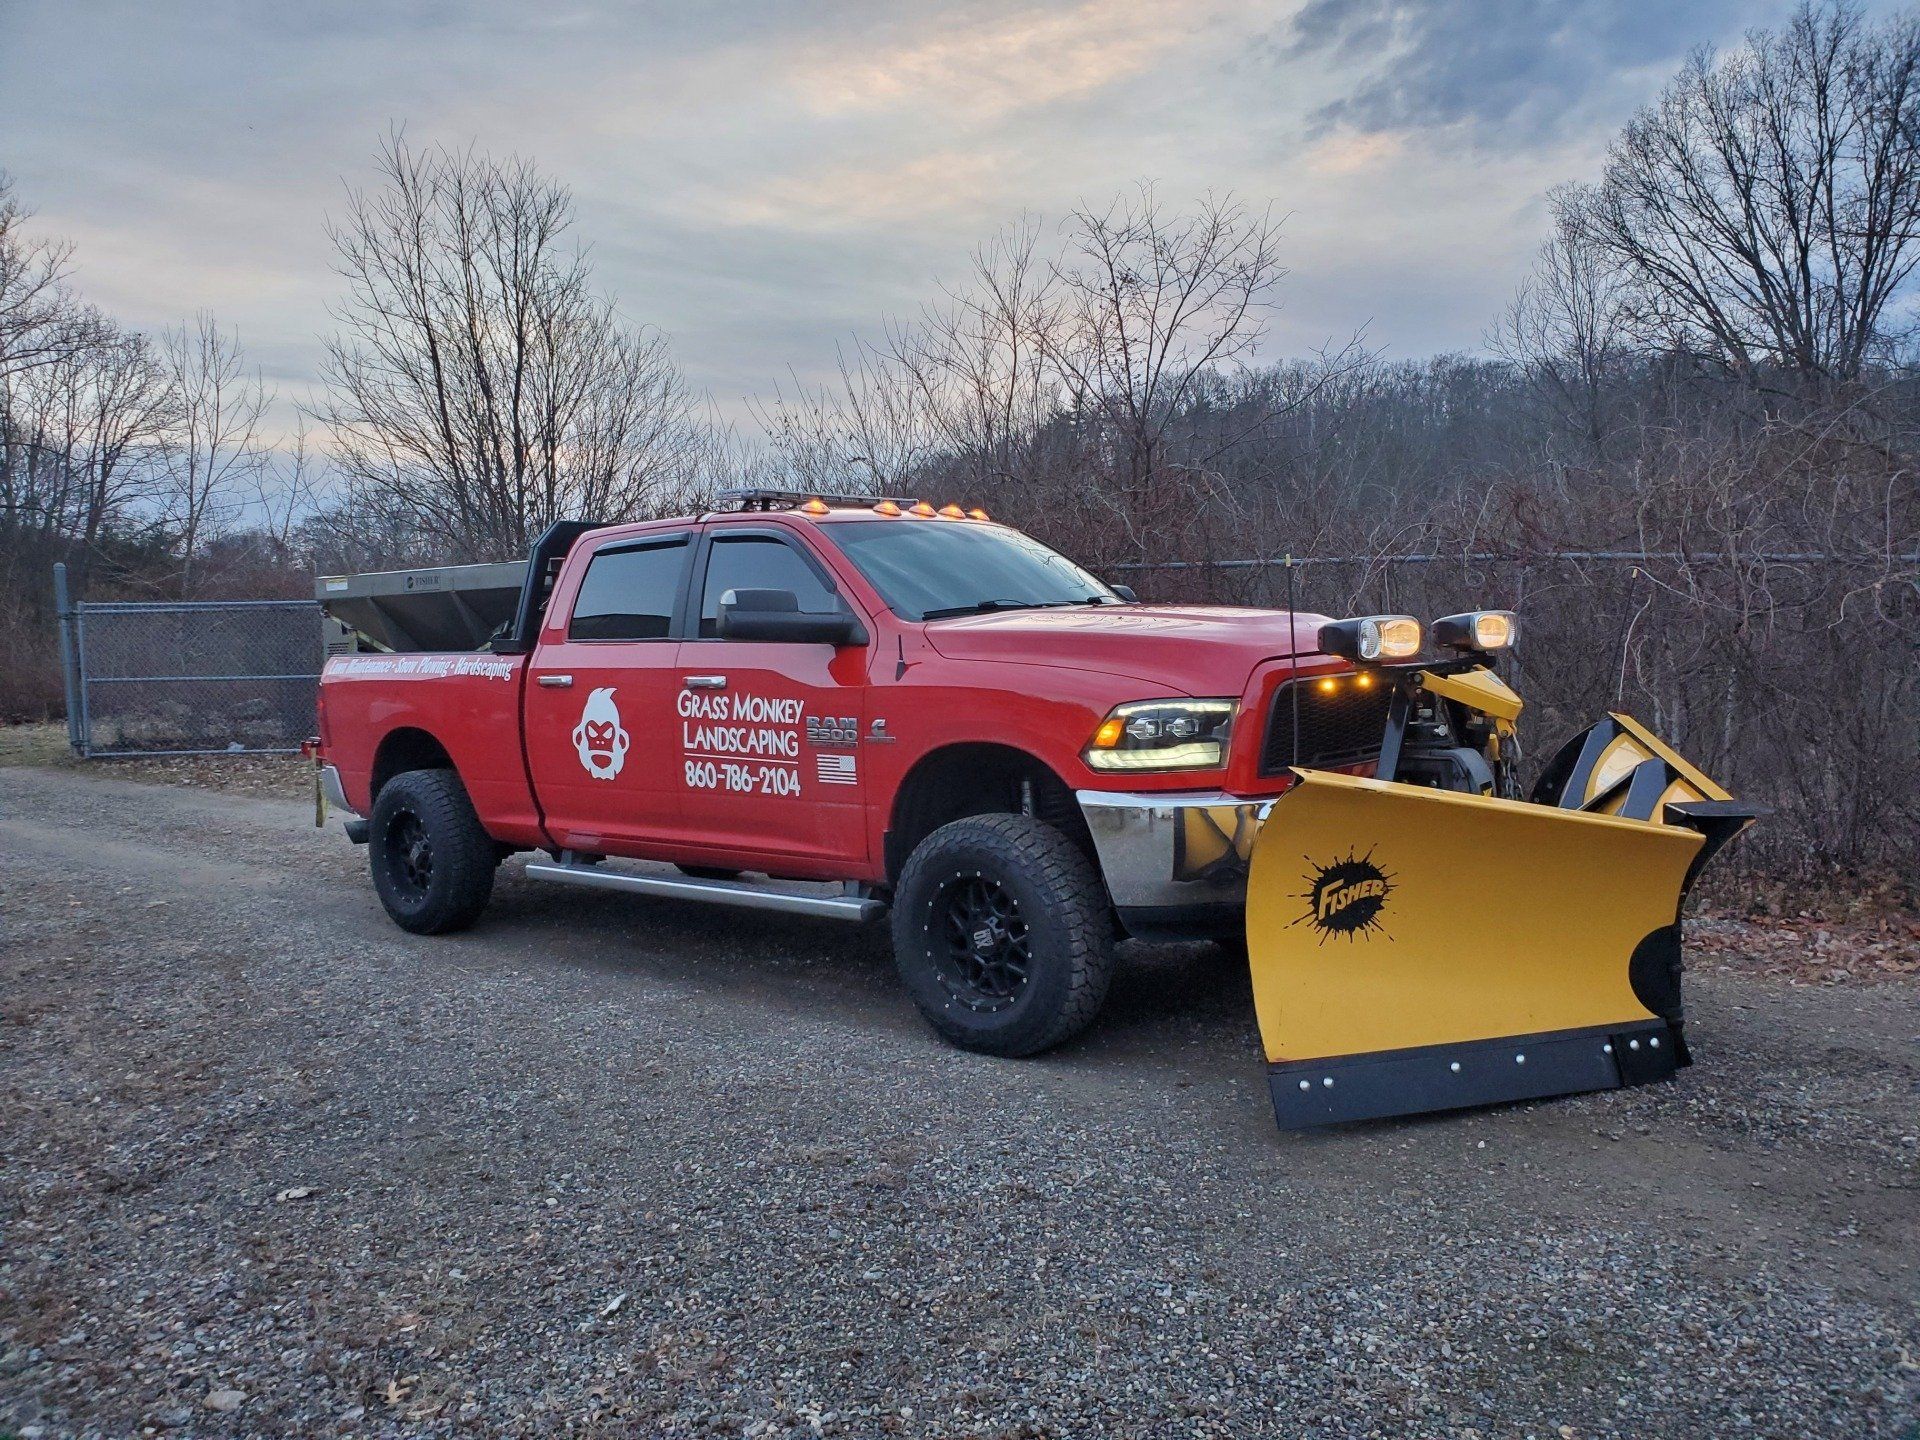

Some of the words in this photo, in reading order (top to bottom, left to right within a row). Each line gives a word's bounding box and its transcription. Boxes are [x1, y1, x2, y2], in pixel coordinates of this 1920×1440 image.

[346, 658, 393, 674] Maintenance
[395, 657, 418, 674] Snow
[417, 657, 451, 677] Plowing
[454, 658, 514, 681] Hardscaping
[677, 689, 729, 720] GRASS
[733, 692, 804, 724] MONKEY
[806, 716, 858, 729] RAM
[683, 721, 799, 757] LANDSCAPING
[806, 728, 858, 741] 2500
[685, 760, 801, 796] 860-786-2104
[1318, 878, 1385, 920] FISHER
